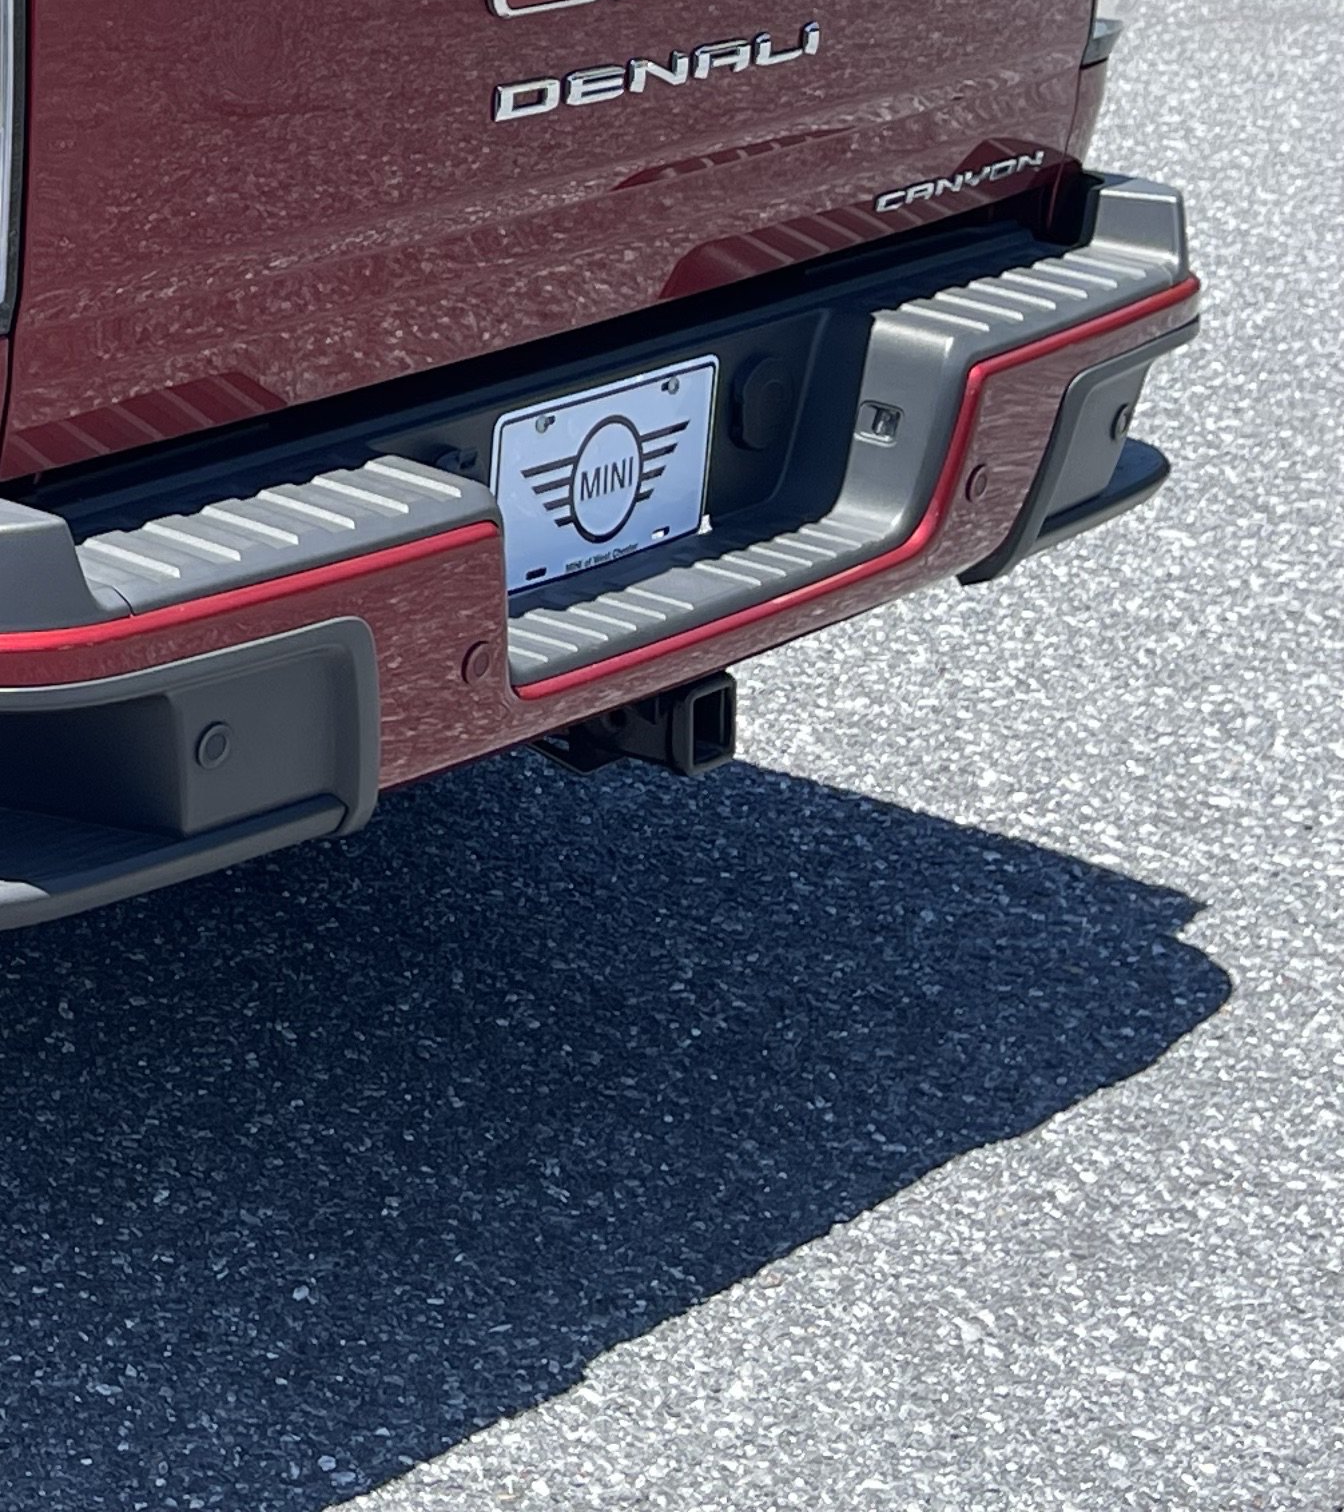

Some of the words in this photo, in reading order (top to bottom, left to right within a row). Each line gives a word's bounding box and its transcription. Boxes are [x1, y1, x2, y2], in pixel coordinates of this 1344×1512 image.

[492, 21, 821, 123] DENALI
[874, 150, 1046, 213] CANYON
[580, 456, 634, 501] MINI
